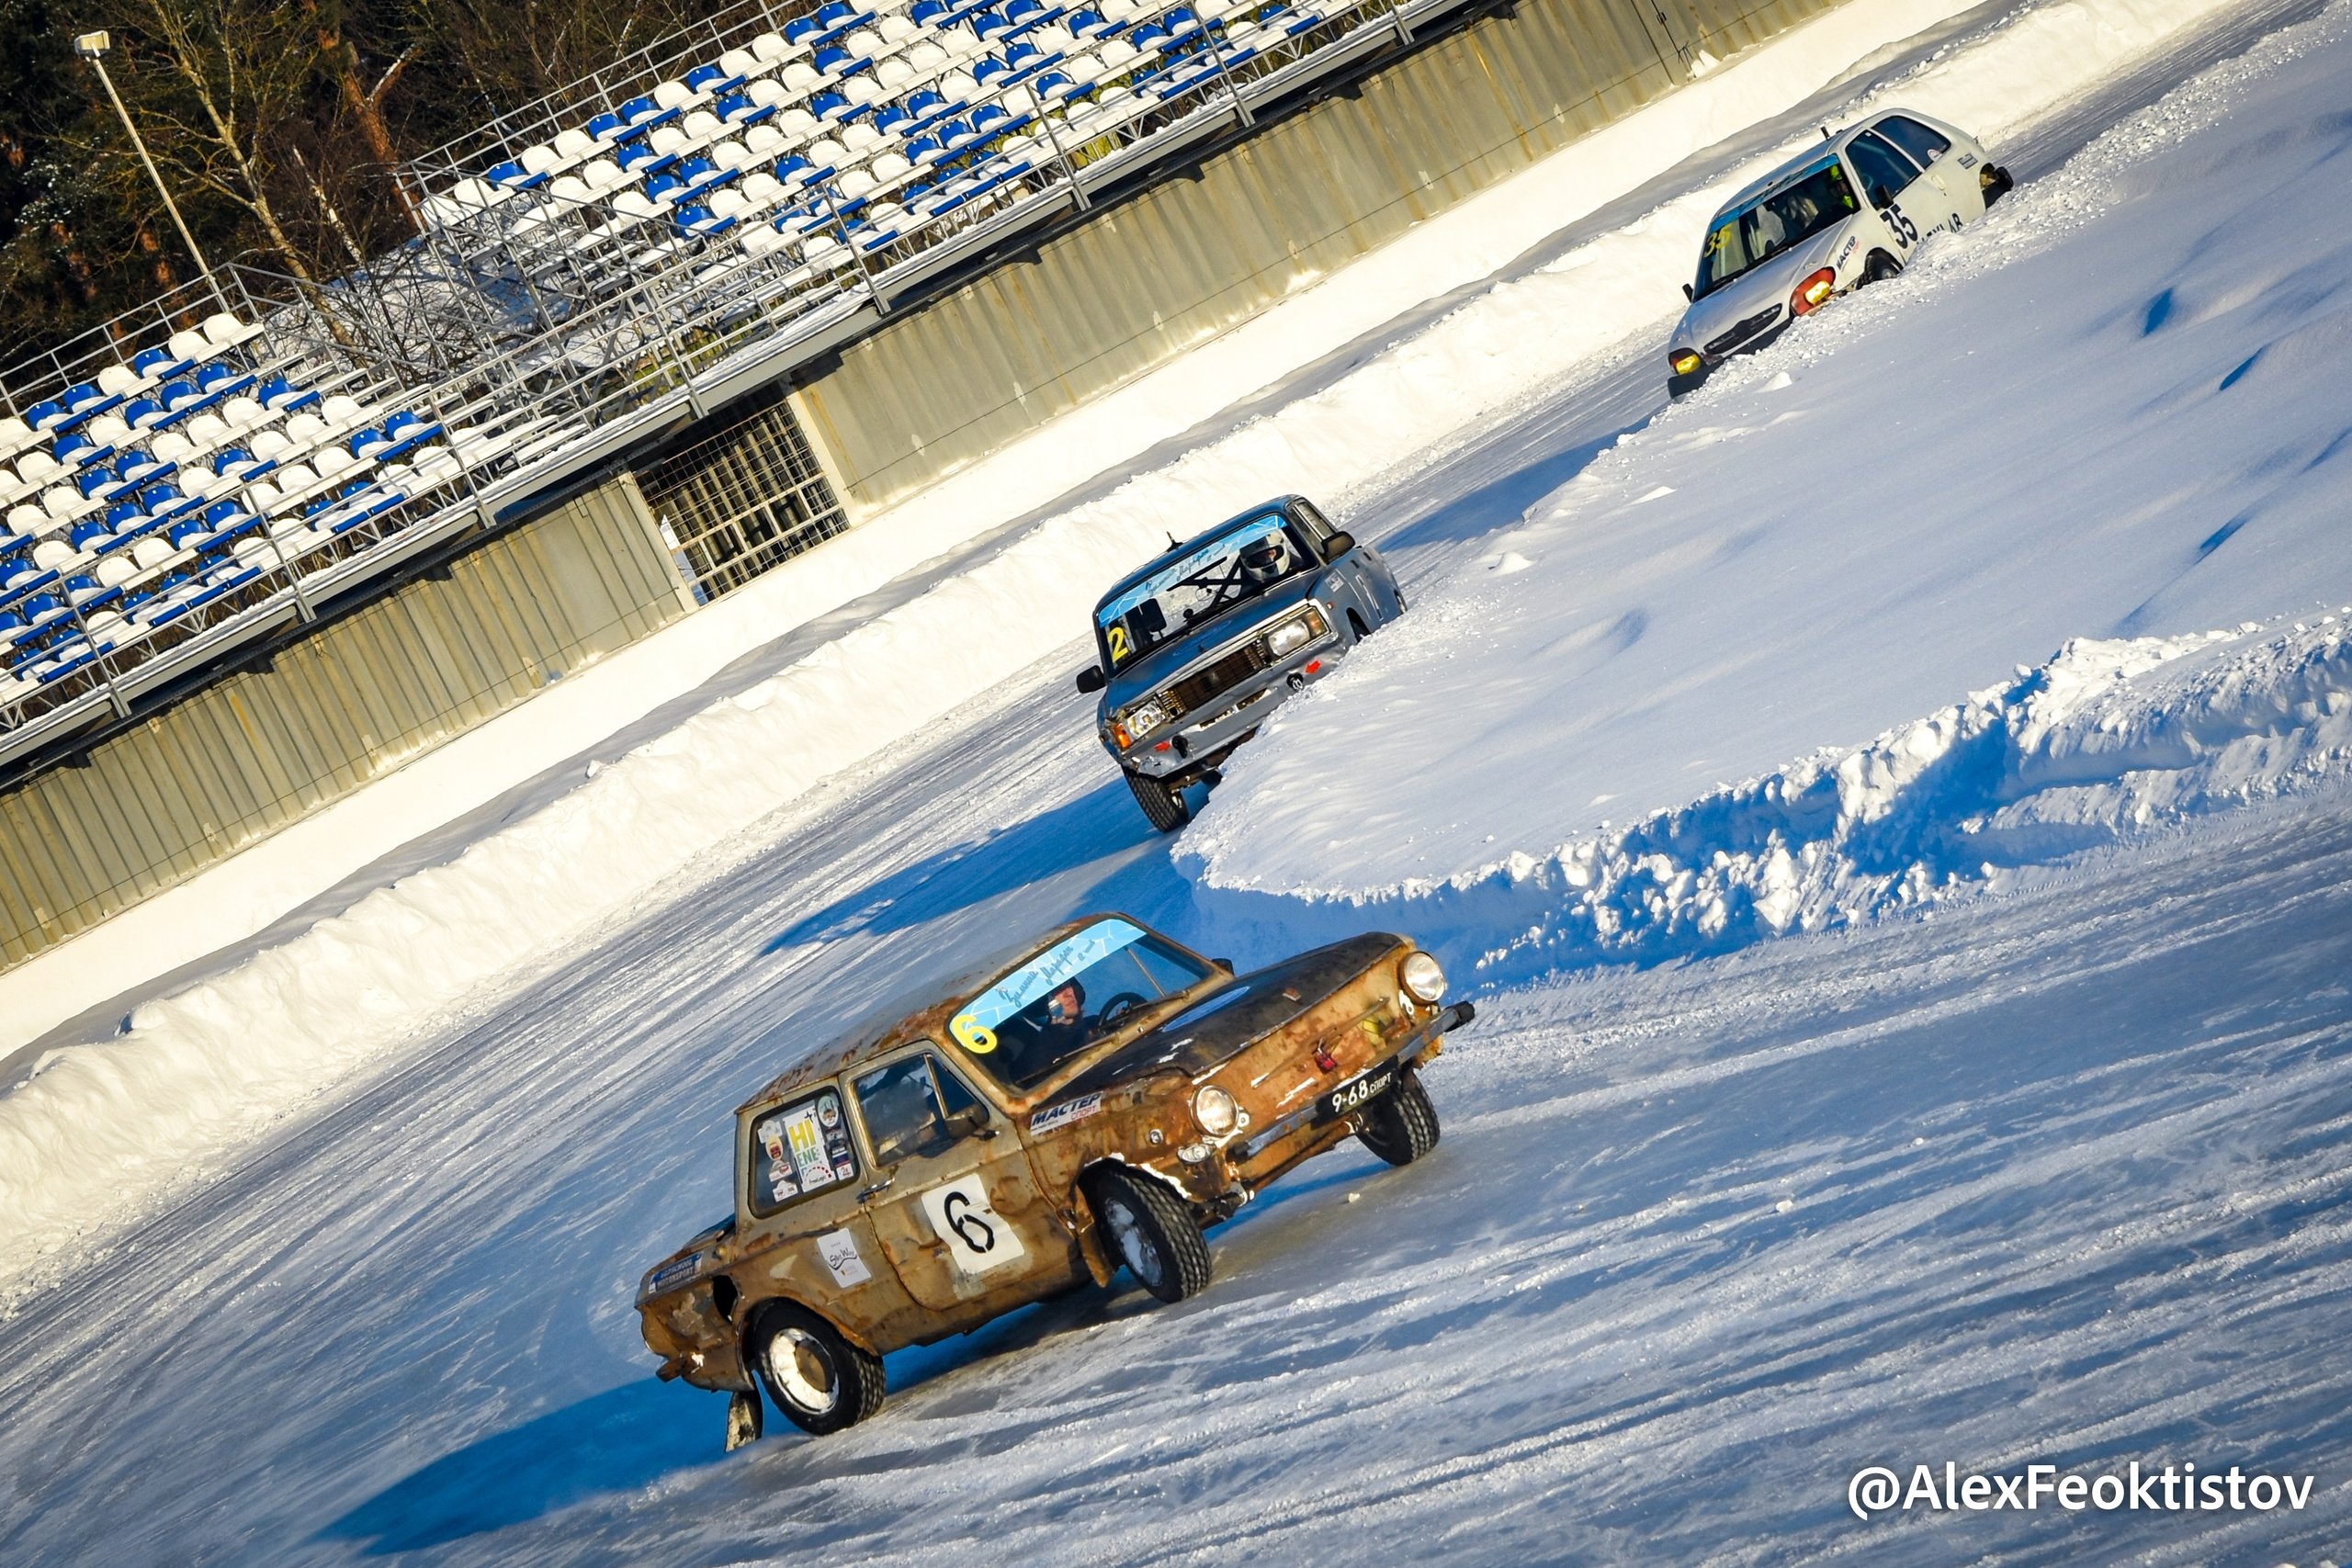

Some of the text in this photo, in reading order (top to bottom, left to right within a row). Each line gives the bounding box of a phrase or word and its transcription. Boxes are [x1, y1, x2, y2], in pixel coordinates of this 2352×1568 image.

[1704, 223, 1733, 257] 35
[1880, 204, 1918, 249] 35
[1108, 626, 1129, 663] 2
[953, 1014, 998, 1055] 6
[1032, 1093, 1102, 1127] МАСТЕР
[1332, 1079, 1368, 1112] 9-68
[788, 1118, 817, 1153] HI
[944, 1190, 995, 1254] 6
